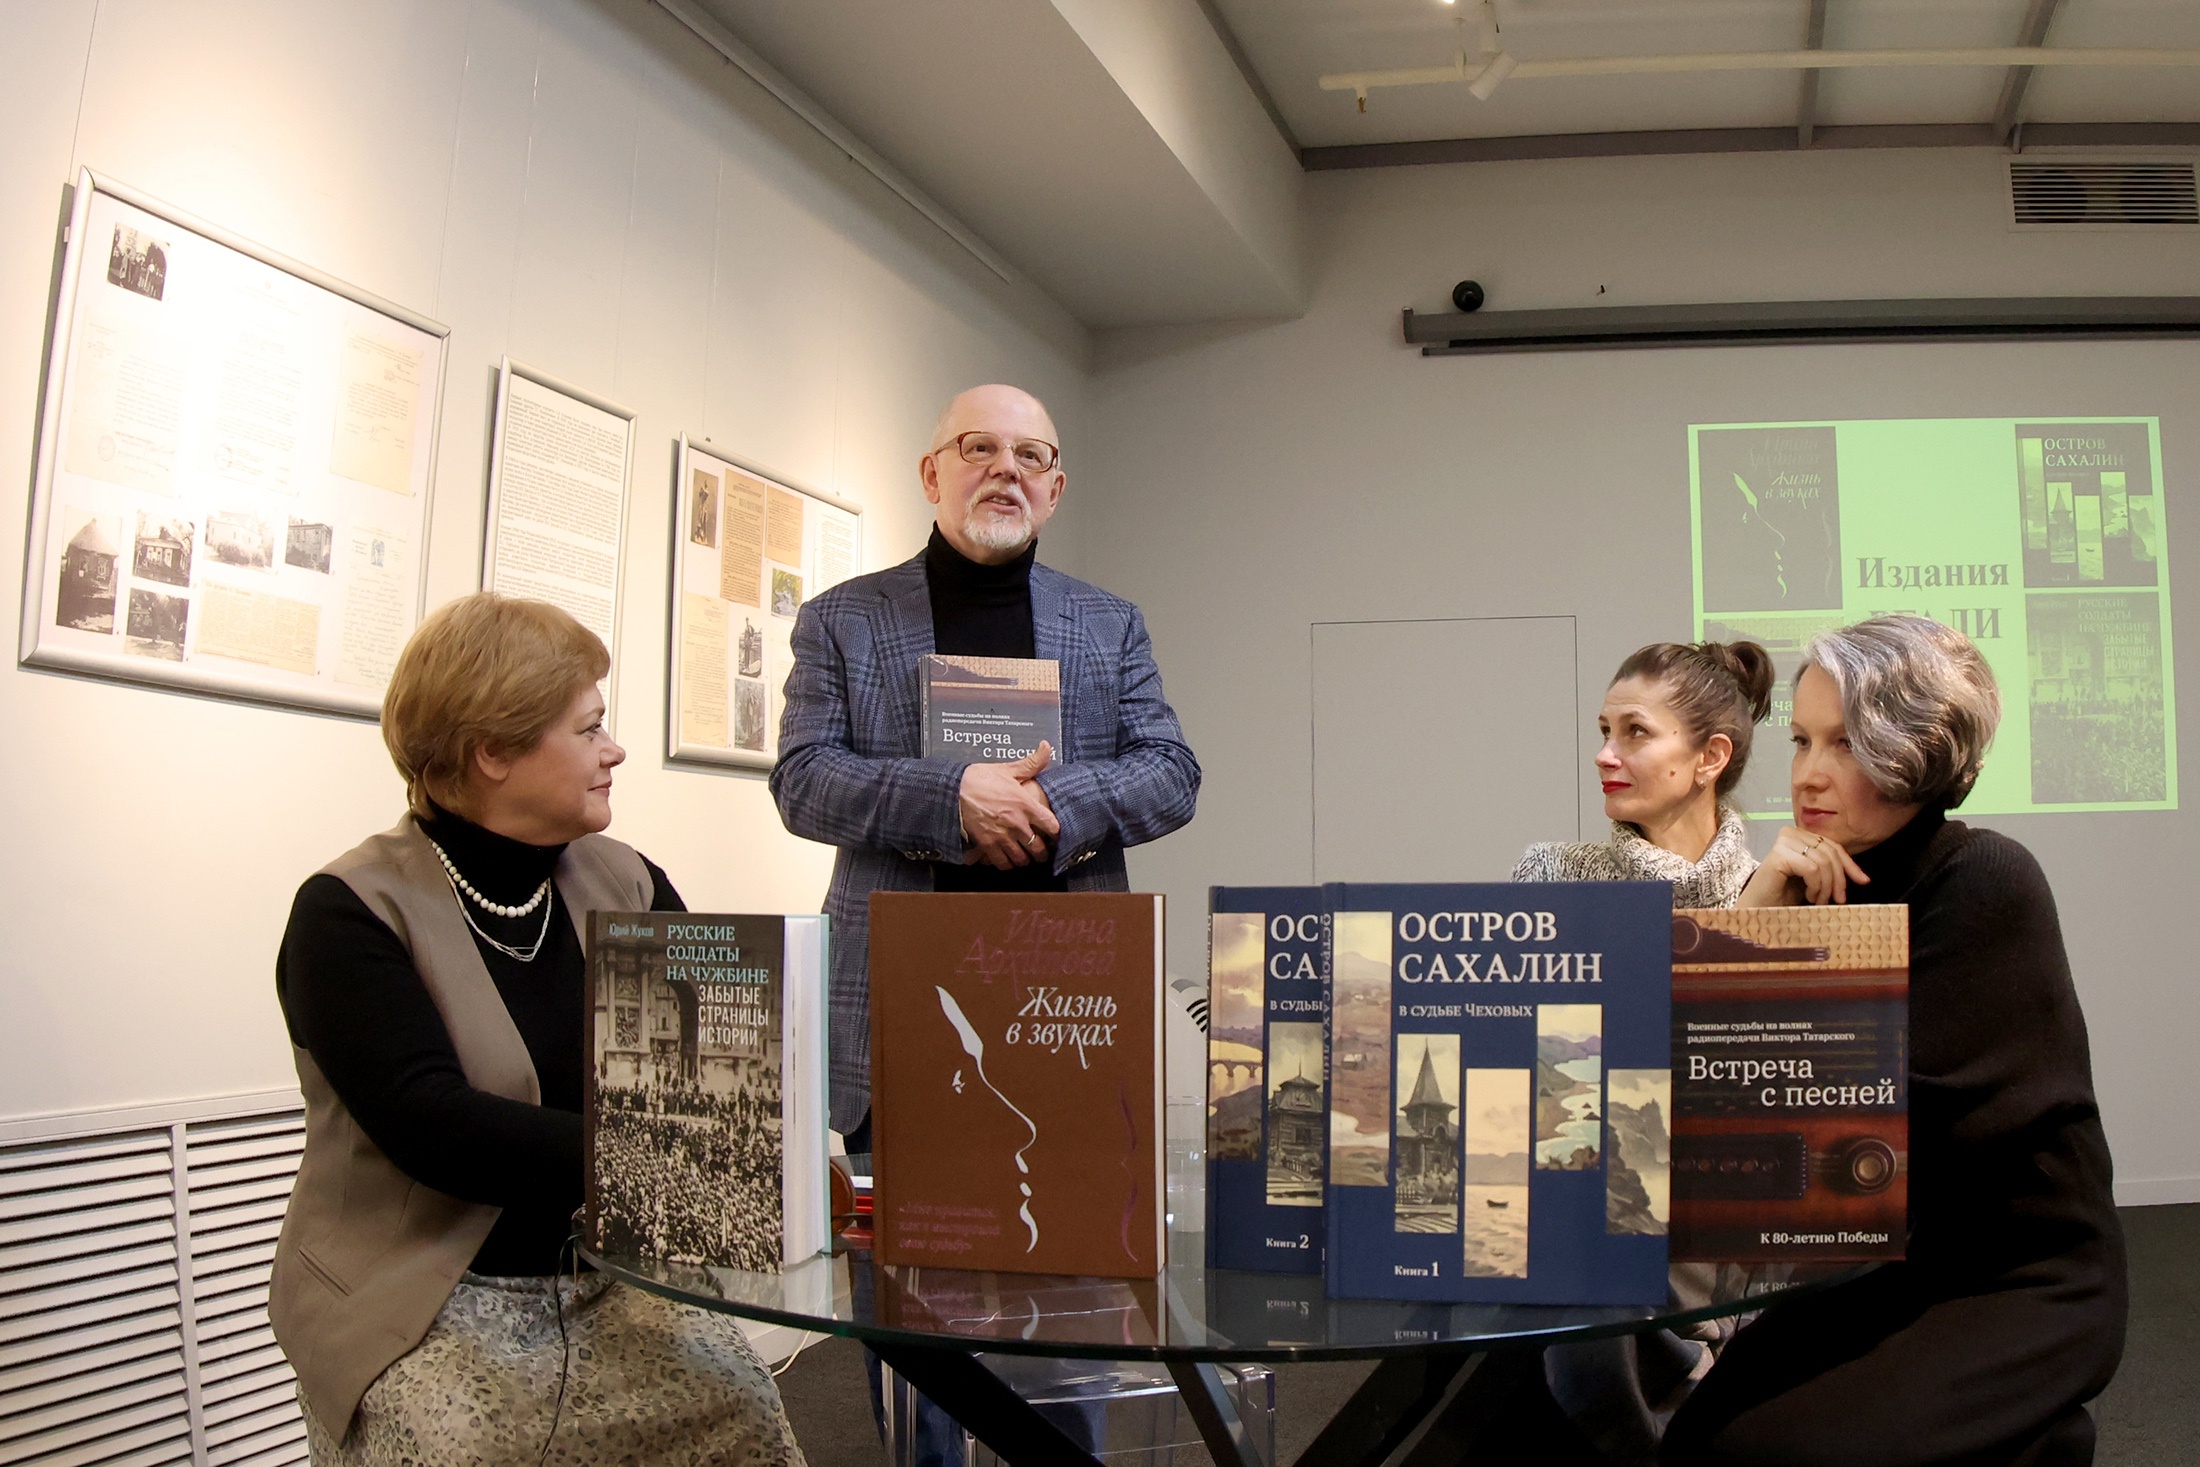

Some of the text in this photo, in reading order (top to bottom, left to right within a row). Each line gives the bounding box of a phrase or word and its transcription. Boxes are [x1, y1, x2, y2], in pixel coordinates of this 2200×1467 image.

[2044, 438, 2106, 450] ОСТРОВ
[2045, 454, 2124, 467] САХАЛИН
[1856, 557, 2009, 591] Издания
[942, 728, 1012, 747] Встреча
[983, 746, 1056, 761] с песнй
[667, 924, 736, 941] РУССКИЕ
[1399, 911, 1558, 943] ОСТРОВ
[666, 945, 740, 963] СОЛДАТЫ
[666, 965, 769, 984] НА ЧУЖБИНЕ
[1398, 953, 1603, 983] САХАЛИН
[698, 985, 760, 1005] ЗАБЫТЫЕ
[1017, 986, 1118, 1018] Жизнь
[698, 1005, 769, 1027] СТРАНИЦЫ
[1410, 1005, 1462, 1018] СУДЬБЕ
[1687, 1021, 1813, 1032] Военные судьбы на волнах
[698, 1026, 758, 1047] ИСТОРИИ
[1005, 1022, 1118, 1070] в звуках
[1687, 1032, 1856, 1045] радиопередачи Виктора Татарского
[1688, 1055, 1815, 1086] Встреча
[1760, 1077, 1897, 1107] с песней
[1266, 1234, 1310, 1249] Книга 2
[1760, 1230, 1889, 1245] К 80-летию Победы
[1394, 1261, 1440, 1277] Книга 1
